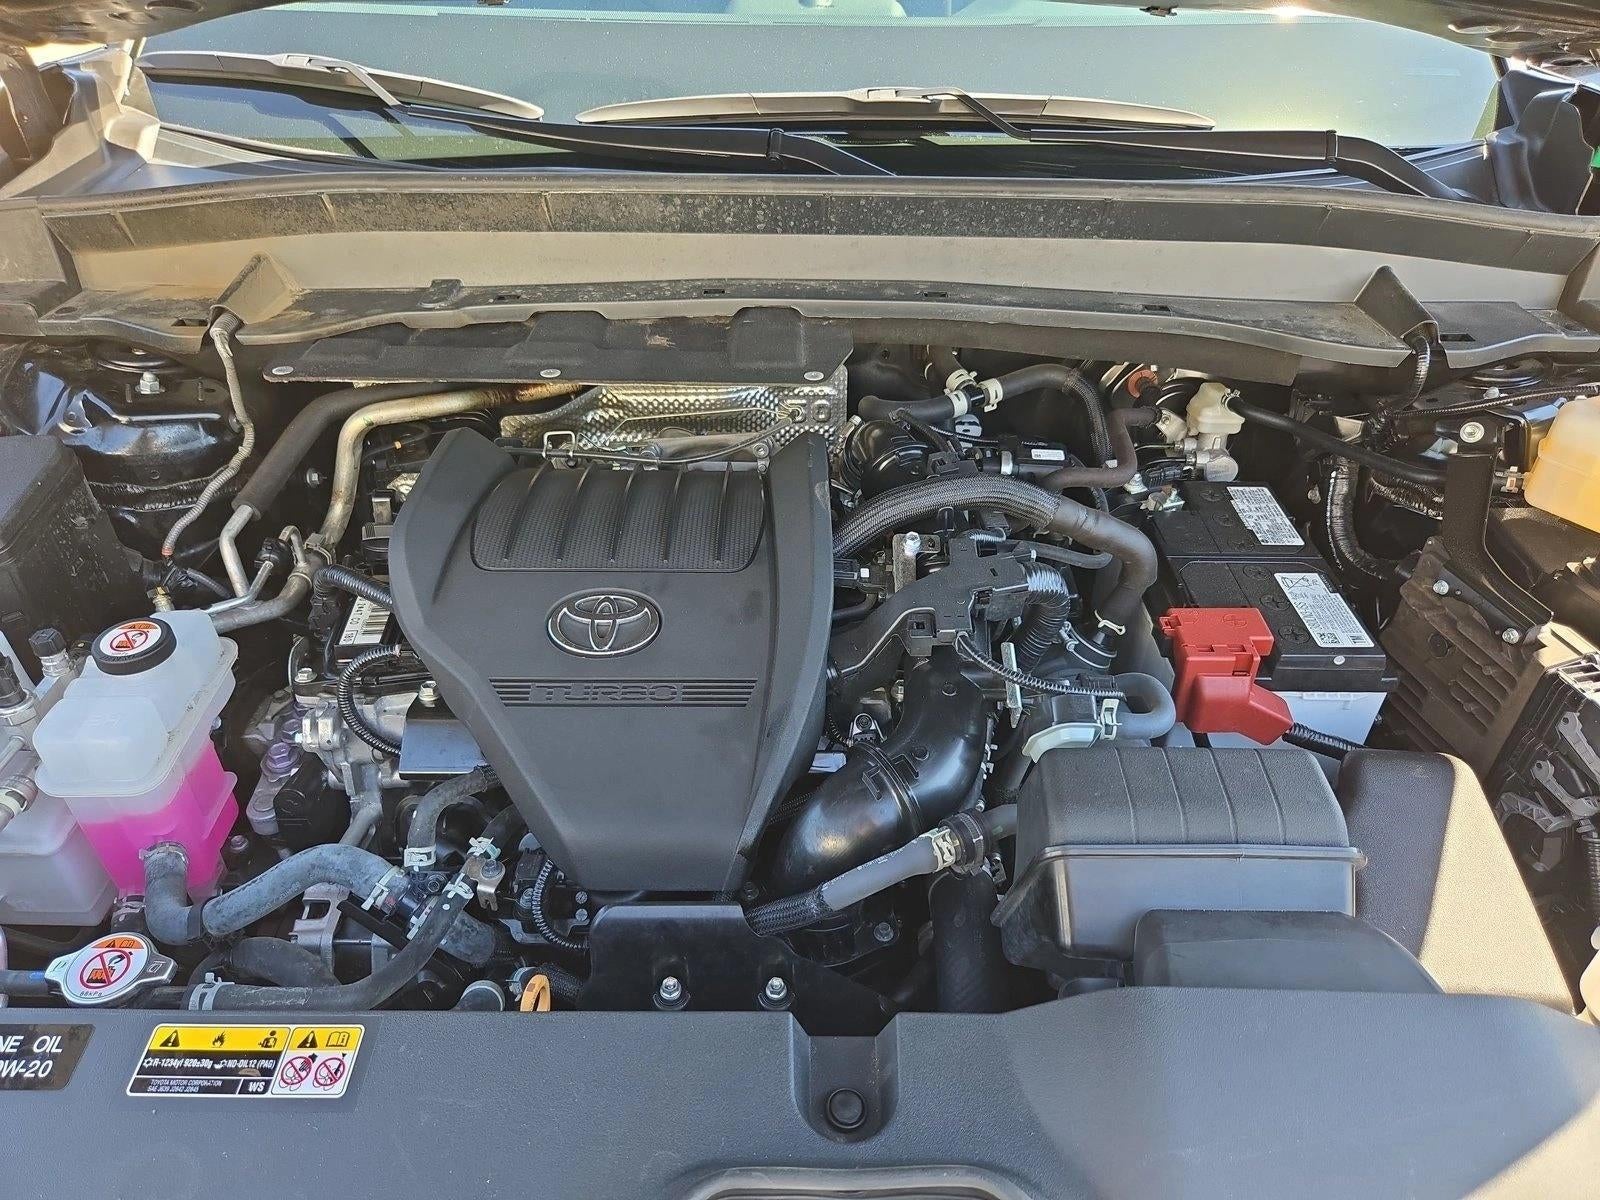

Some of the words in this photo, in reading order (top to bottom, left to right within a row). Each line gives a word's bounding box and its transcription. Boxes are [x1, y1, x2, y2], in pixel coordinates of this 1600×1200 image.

[534, 682, 678, 702] TURBO
[33, 1035, 63, 1053] OIL
[256, 1059, 276, 1070] (PAG)
[248, 1081, 266, 1092] WS
